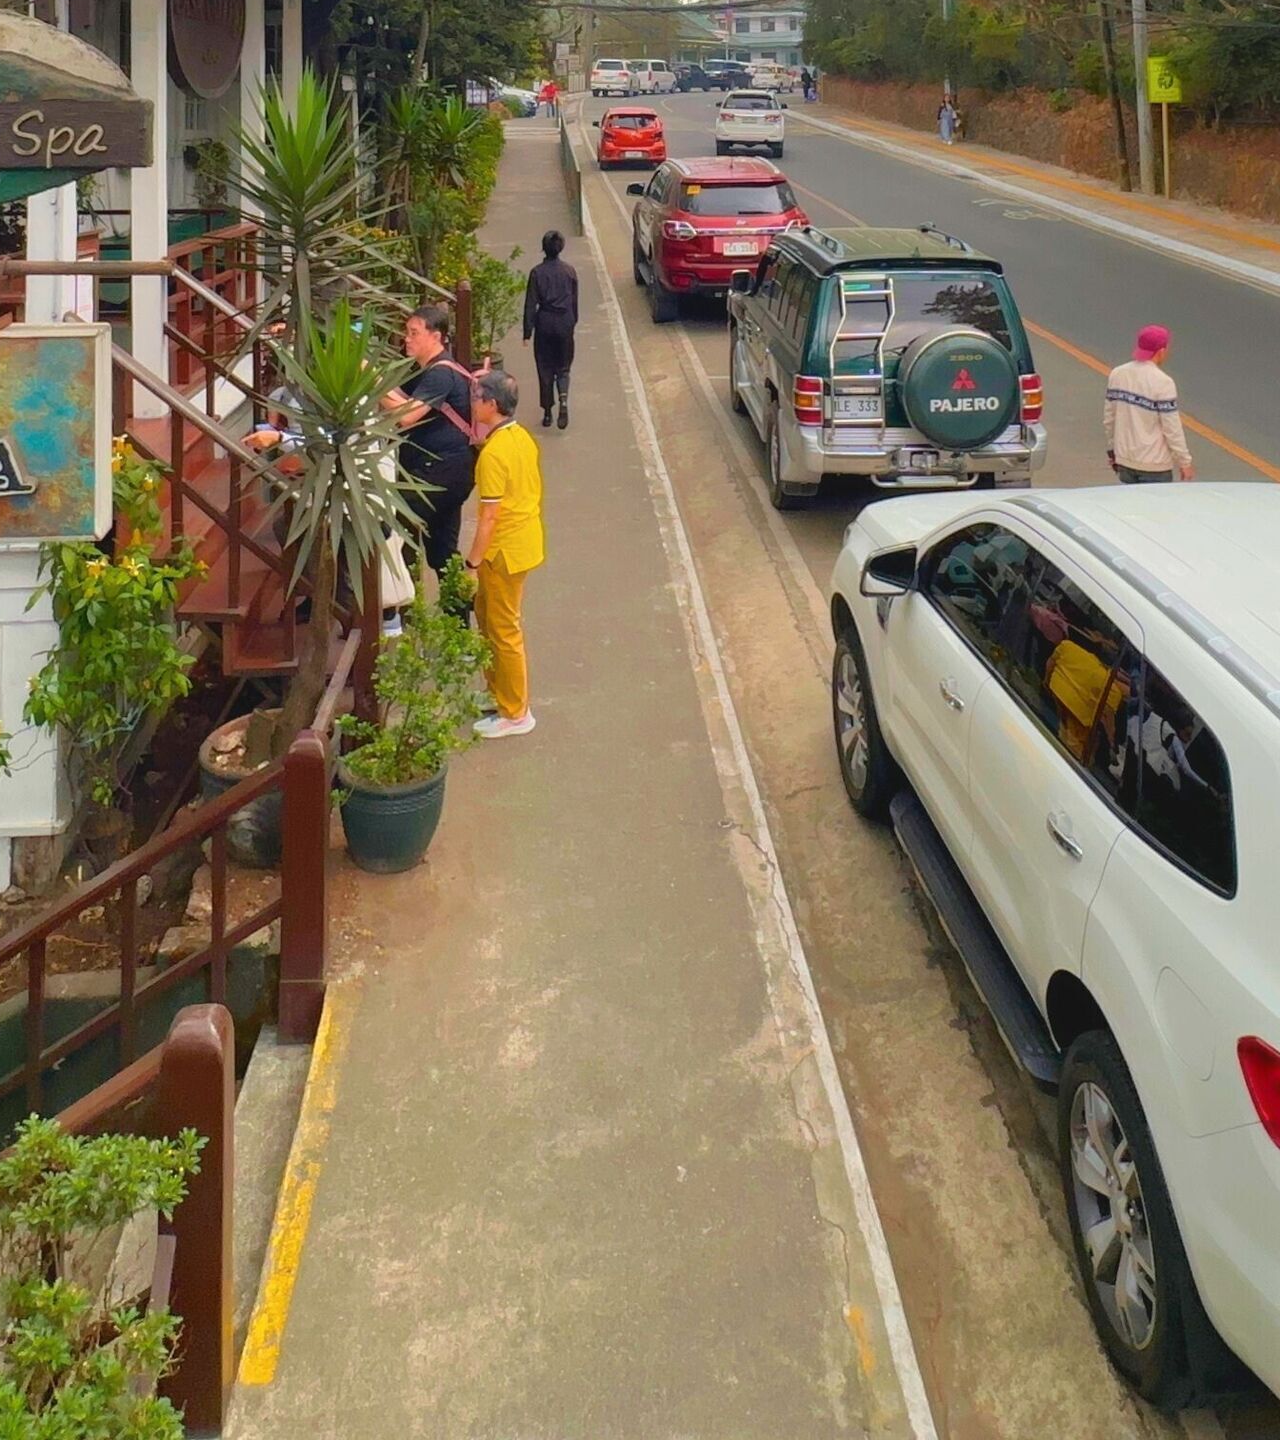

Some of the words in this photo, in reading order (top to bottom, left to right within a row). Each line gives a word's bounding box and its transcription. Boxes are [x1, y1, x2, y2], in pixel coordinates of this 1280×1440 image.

[11, 109, 108, 169] Spa
[858, 400, 878, 412] 333
[929, 396, 999, 412] PAJERO
